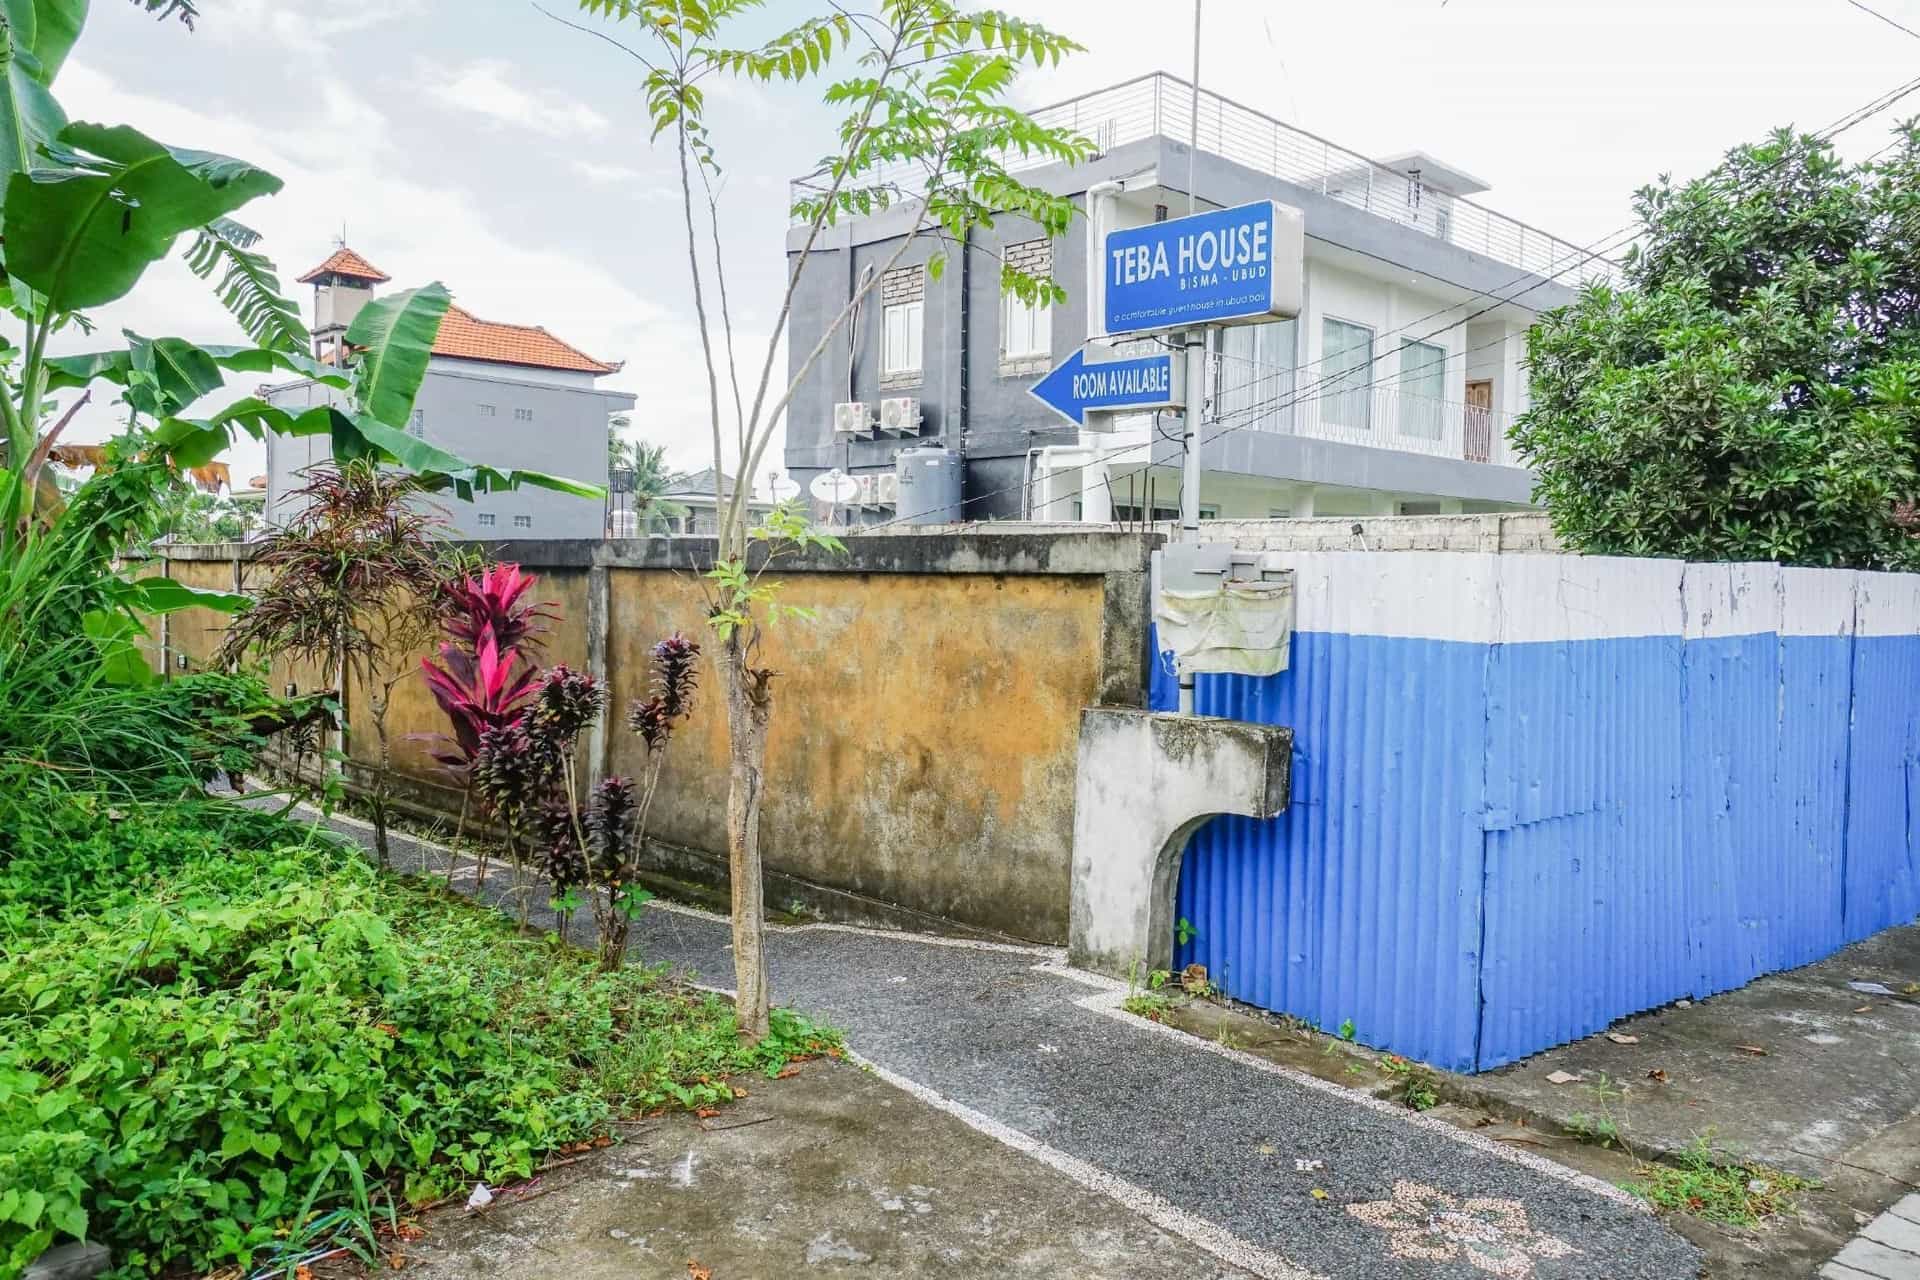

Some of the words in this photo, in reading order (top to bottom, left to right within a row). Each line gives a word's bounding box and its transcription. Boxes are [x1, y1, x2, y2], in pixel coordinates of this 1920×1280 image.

[1113, 241, 1170, 286] TEBA
[1178, 221, 1268, 274] HOUSE
[1180, 272, 1218, 290] BISMA
[1232, 265, 1266, 282] UBUD
[1073, 371, 1107, 399] ROOM
[1109, 366, 1168, 396] AVAILABLE
